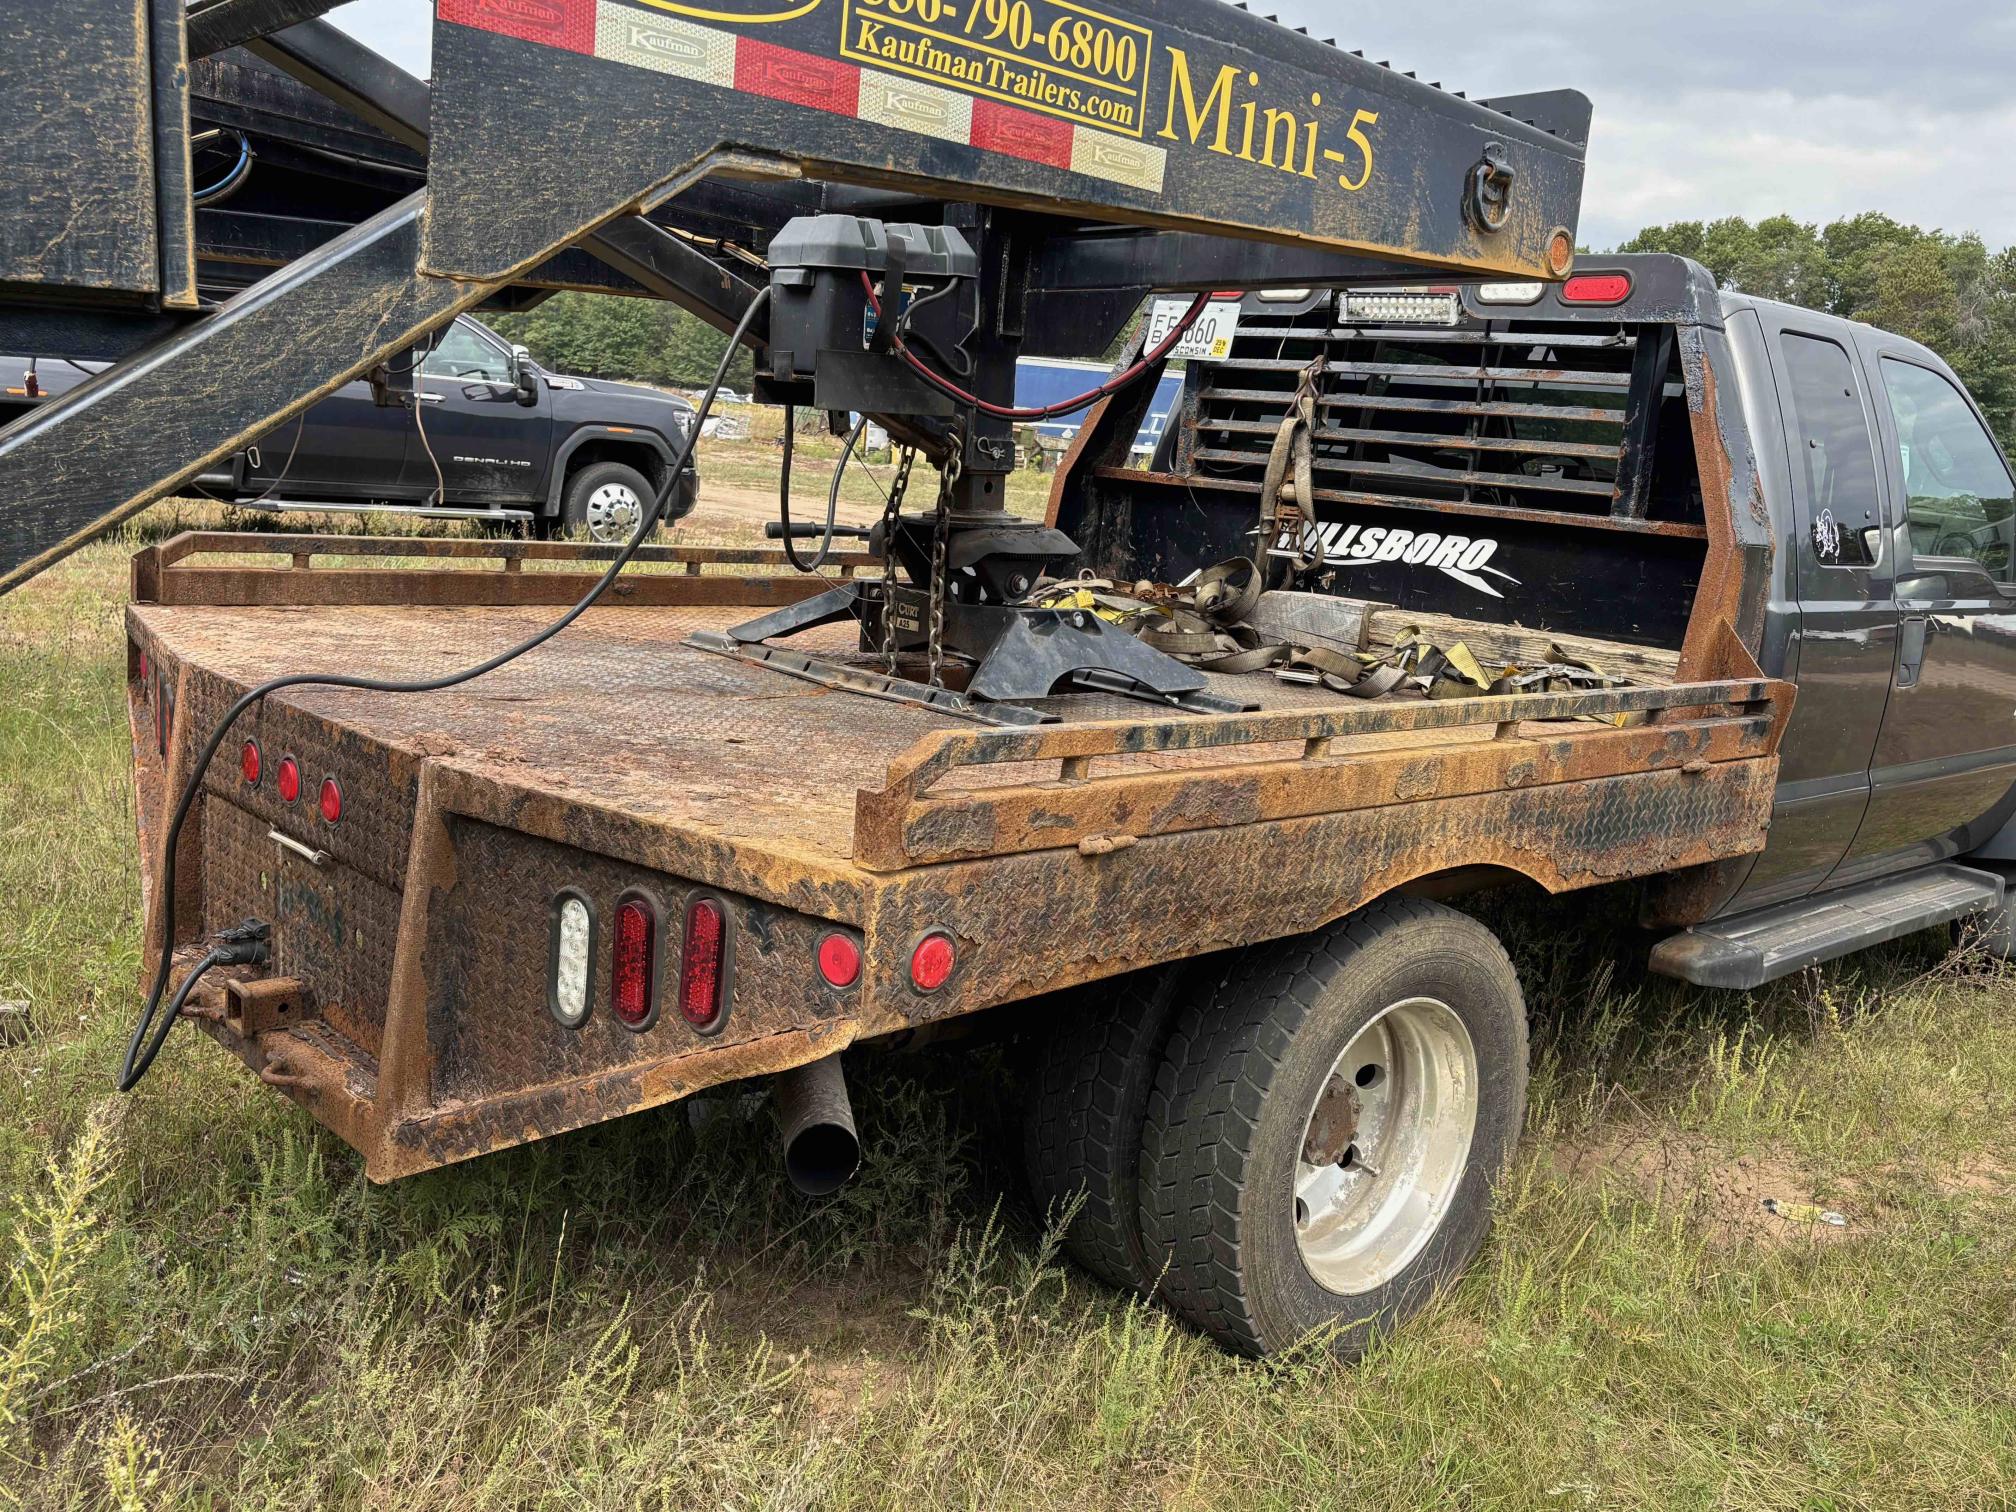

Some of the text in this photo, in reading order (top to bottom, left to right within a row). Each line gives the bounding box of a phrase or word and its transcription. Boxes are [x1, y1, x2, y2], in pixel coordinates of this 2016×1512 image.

[628, 26, 700, 57] Kaufman
[864, 0, 1137, 82] -790-6800
[766, 61, 828, 88] Kaufman
[855, 18, 1134, 126] KaufmanTrailers.com
[886, 91, 943, 116] Kaufman
[1157, 46, 1380, 191] Mini-5
[1094, 144, 1142, 168] Kaufman
[1174, 345, 1207, 355] SCONSIN
[1213, 346, 1224, 354] DEC
[453, 455, 508, 465] DENALI
[898, 602, 920, 618] CURT
